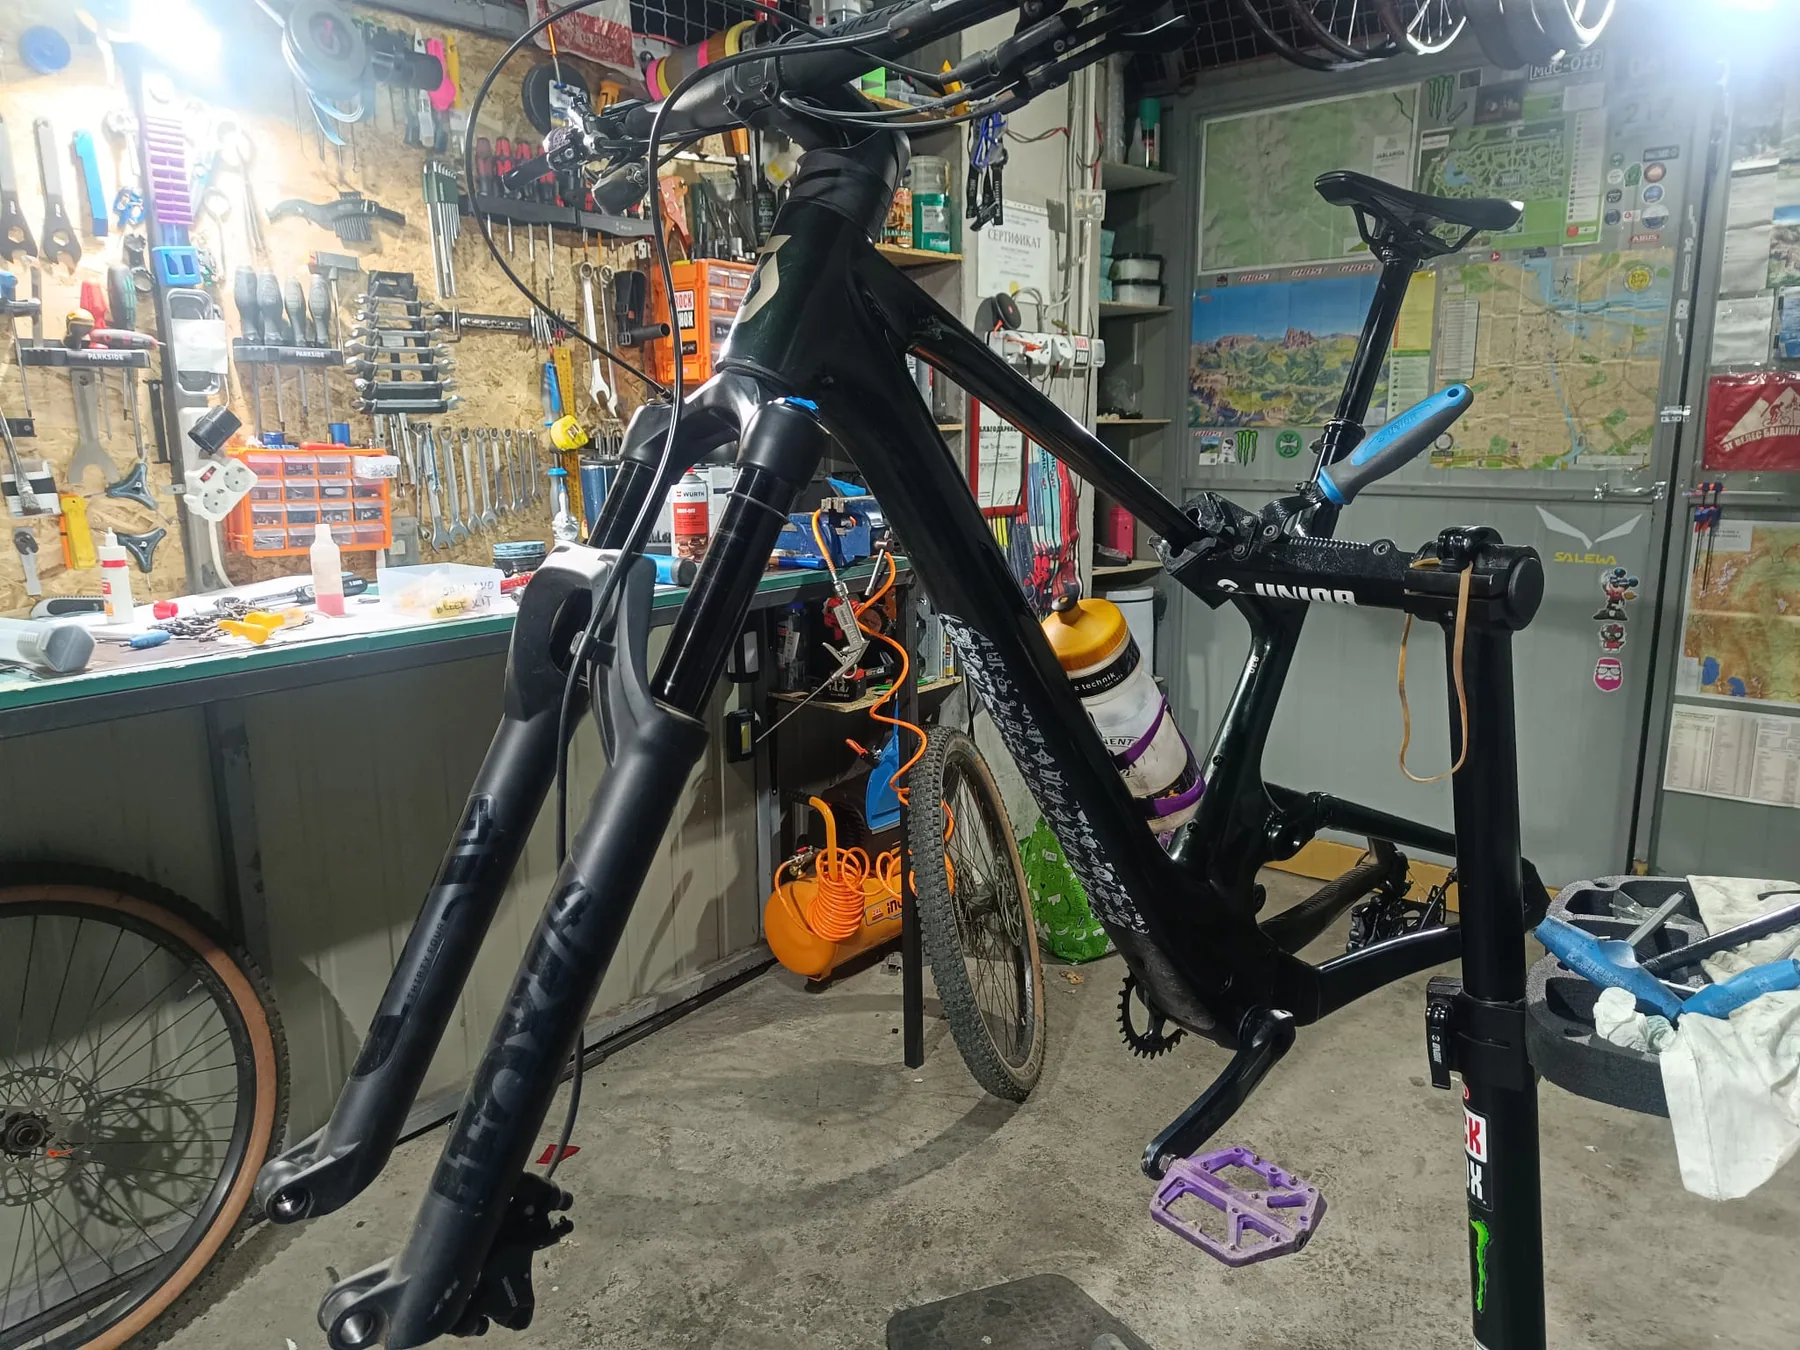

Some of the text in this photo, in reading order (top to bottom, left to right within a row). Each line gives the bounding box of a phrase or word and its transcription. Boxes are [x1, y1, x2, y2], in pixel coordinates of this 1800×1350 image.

[988, 228, 1041, 248] СЕРТИФИКАТ
[87, 353, 125, 361] PARKSIDE
[1554, 551, 1617, 565] SALEWA
[1081, 671, 1117, 690] technik
[406, 922, 445, 1000] THIRTY FOUR
